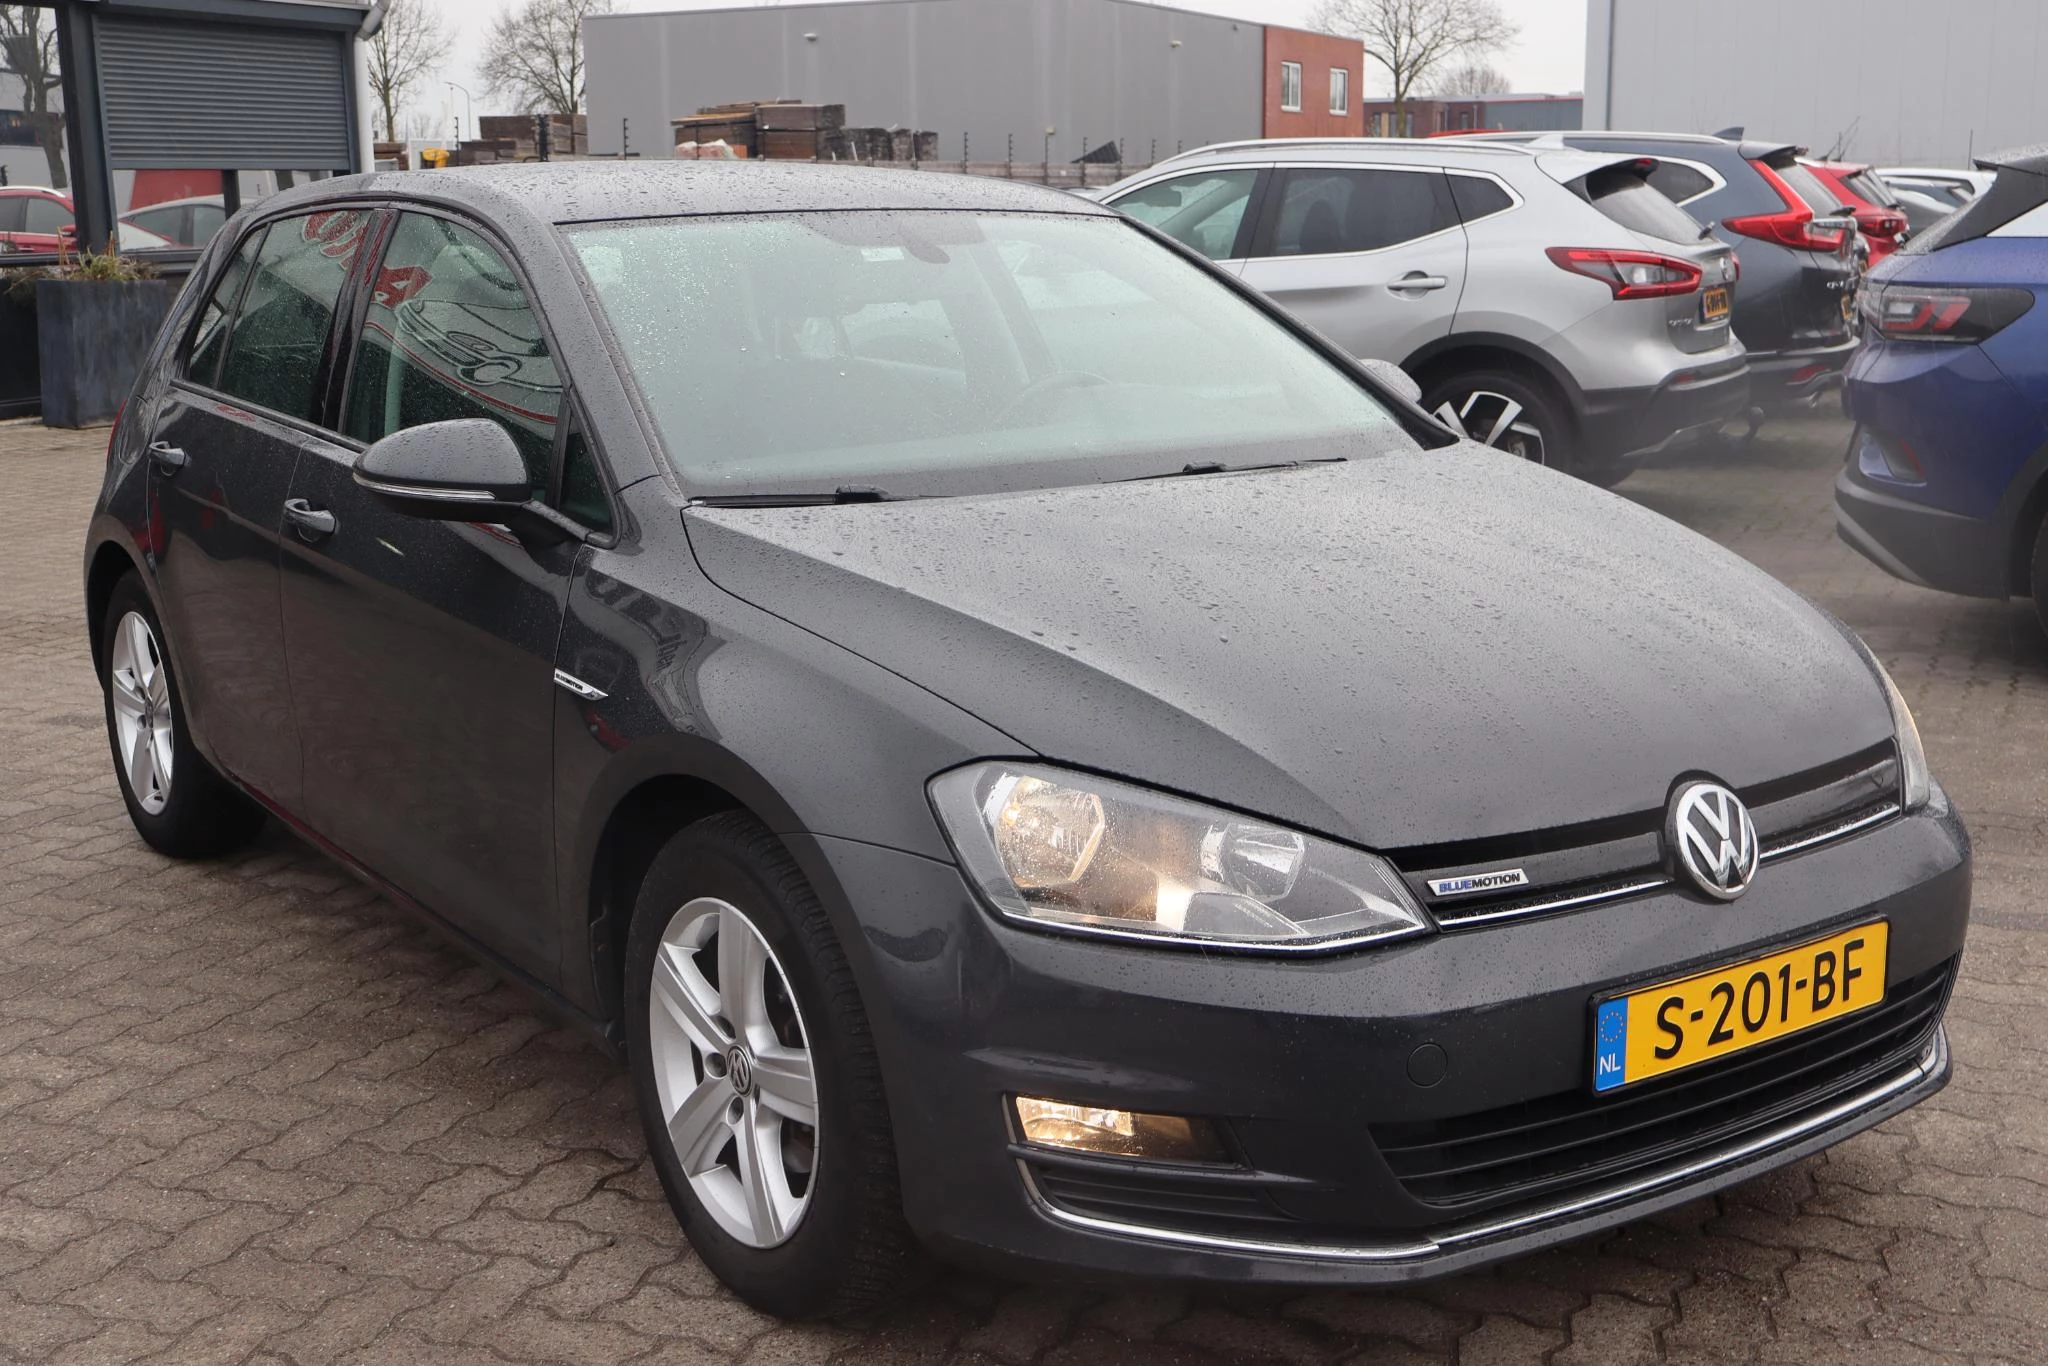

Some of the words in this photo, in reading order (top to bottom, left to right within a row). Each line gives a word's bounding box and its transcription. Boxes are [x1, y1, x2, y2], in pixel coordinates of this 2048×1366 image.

[1676, 783, 1759, 893] VW
[1439, 873, 1520, 892] BLUEMOTION
[1654, 939, 1865, 1060] S-201-BF
[1599, 1053, 1621, 1075] NL
